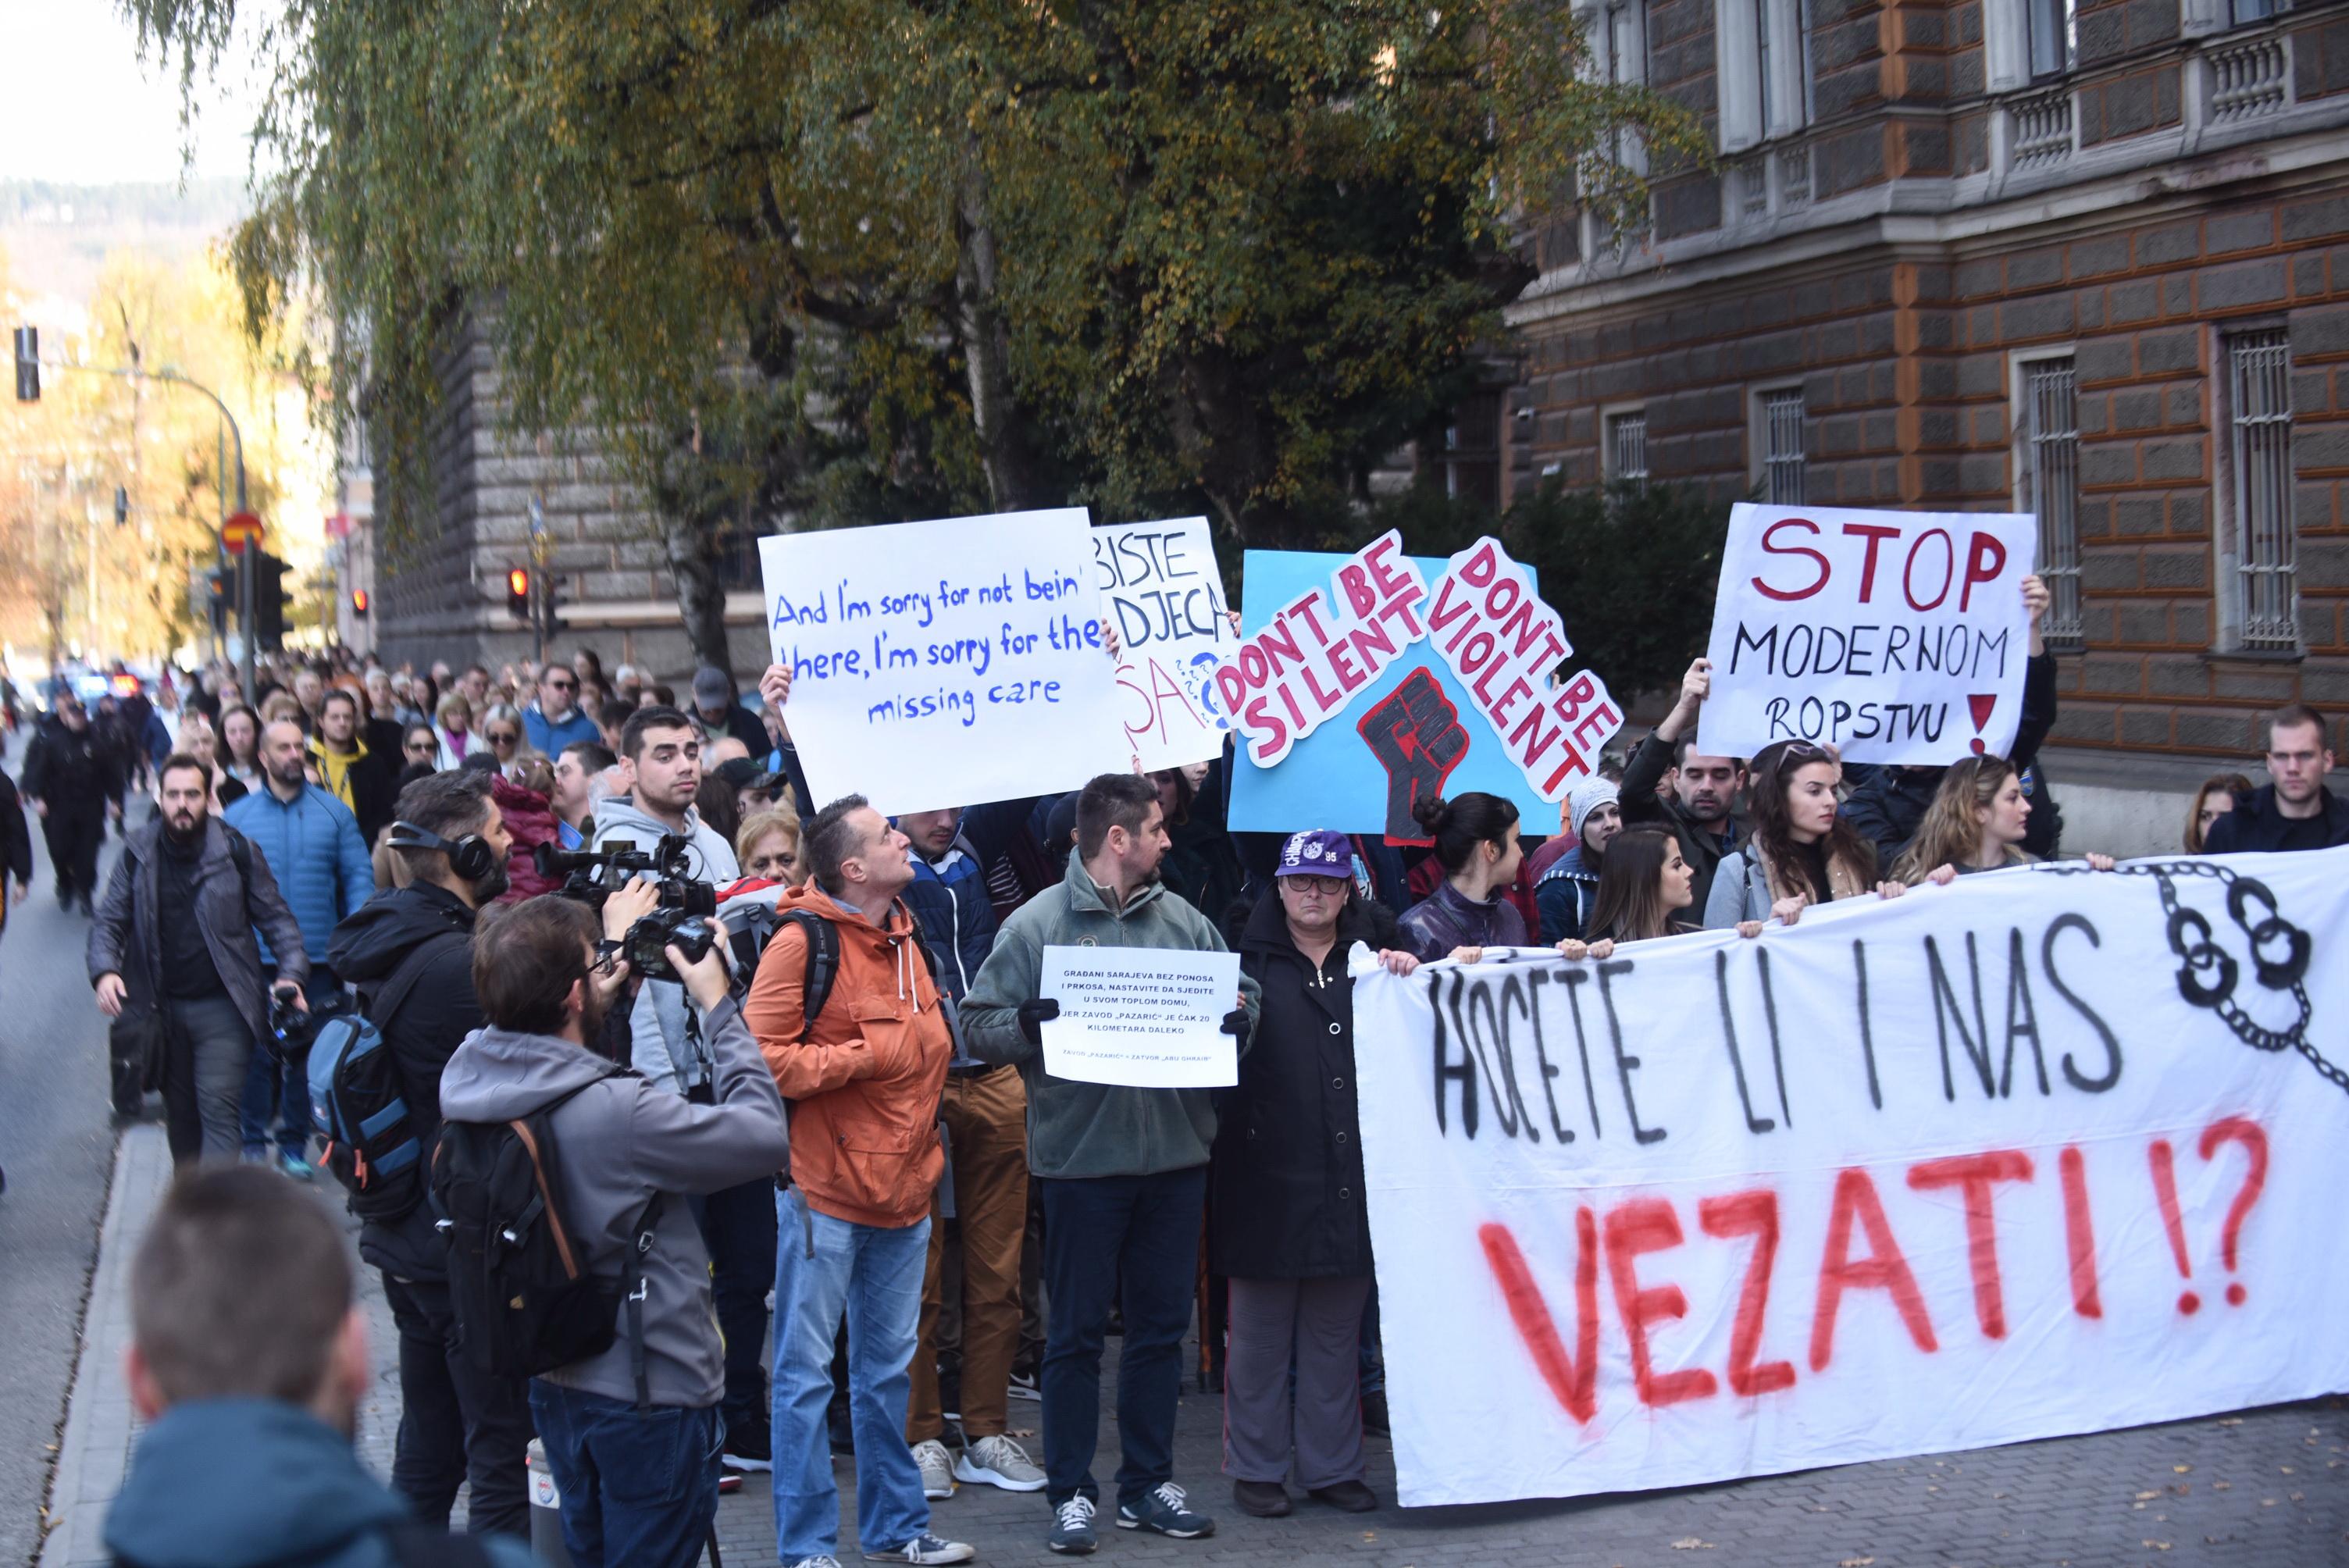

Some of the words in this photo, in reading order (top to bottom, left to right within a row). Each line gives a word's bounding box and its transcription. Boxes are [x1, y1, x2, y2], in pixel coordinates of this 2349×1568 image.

[1750, 517, 2007, 613] STOP
[774, 590, 827, 630] And
[838, 579, 871, 622] I'm
[880, 593, 933, 628] sorry
[937, 580, 969, 608] for
[978, 572, 1012, 604] not
[1113, 582, 1240, 647] DJECA
[1215, 592, 1328, 716] DON'T
[1338, 537, 1413, 619] BE
[927, 636, 990, 676] sorry
[1000, 622, 1038, 655] for
[1047, 614, 1100, 650] the
[1244, 586, 1423, 759] SILENT
[1459, 543, 1565, 676] DON'T
[1552, 675, 1619, 753] BE
[1729, 621, 2008, 679] MODERNOM
[868, 687, 975, 727] missing
[988, 679, 1061, 704] care
[1428, 576, 1591, 796] VIOLENT
[1067, 983, 1106, 992] PRKOSA,
[1109, 984, 1159, 992] NASTAVITE
[1107, 971, 1153, 980] SARAJEVA
[1176, 974, 1214, 982] PONOSA
[1160, 999, 1190, 1007] DOMU,
[1717, 946, 1790, 1135] LI
[1853, 938, 1882, 1110] I
[1923, 912, 2123, 1102] NAS
